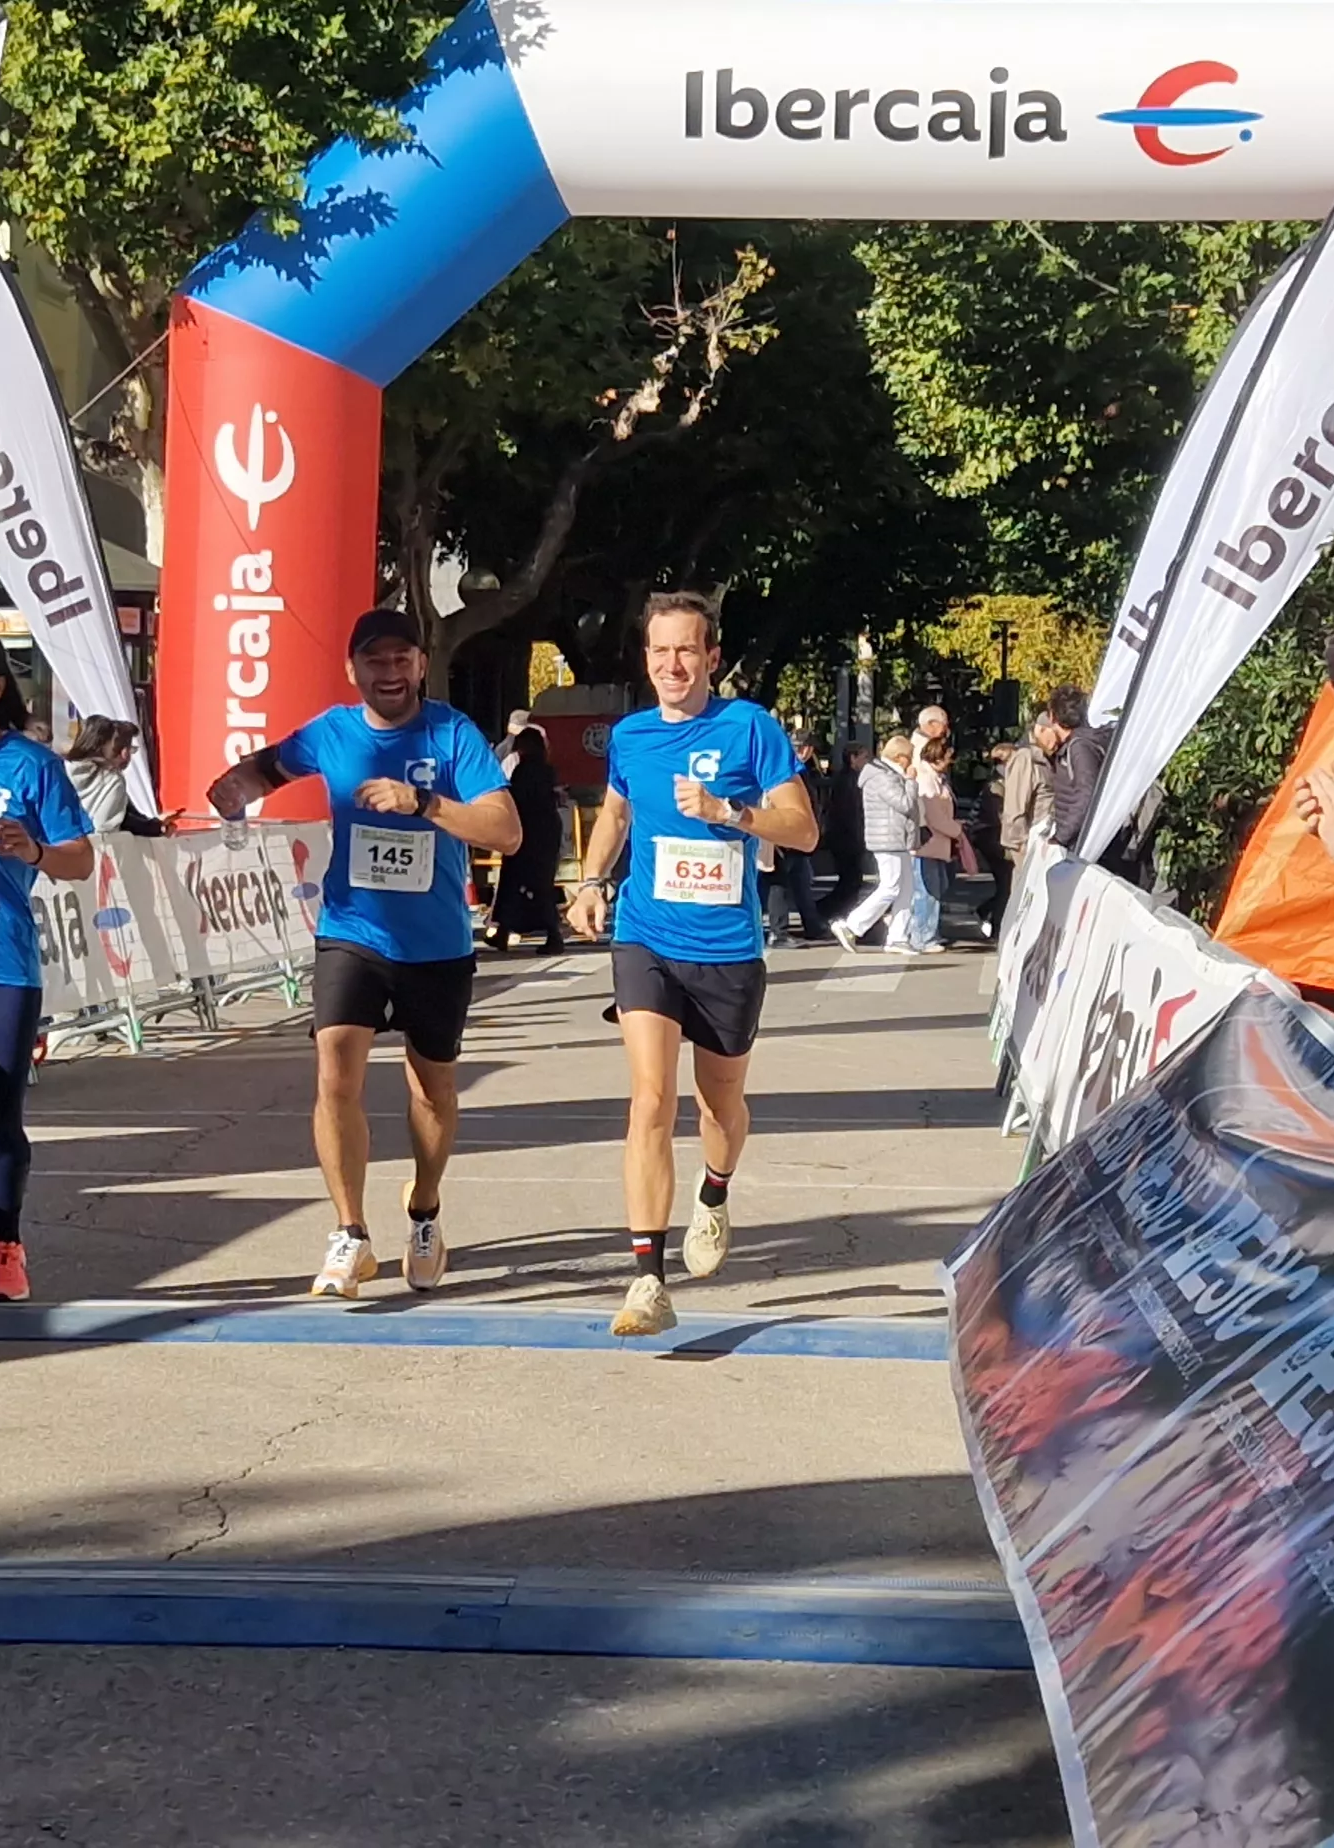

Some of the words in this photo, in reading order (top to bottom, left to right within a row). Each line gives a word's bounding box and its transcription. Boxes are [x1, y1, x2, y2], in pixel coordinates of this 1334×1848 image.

[684, 67, 1068, 160] Ibercaja
[210, 548, 285, 819] ercaja
[368, 845, 414, 866] 145
[371, 865, 409, 875] OSCAR
[676, 860, 724, 881] 634
[1174, 1212, 1321, 1342] ESIC
